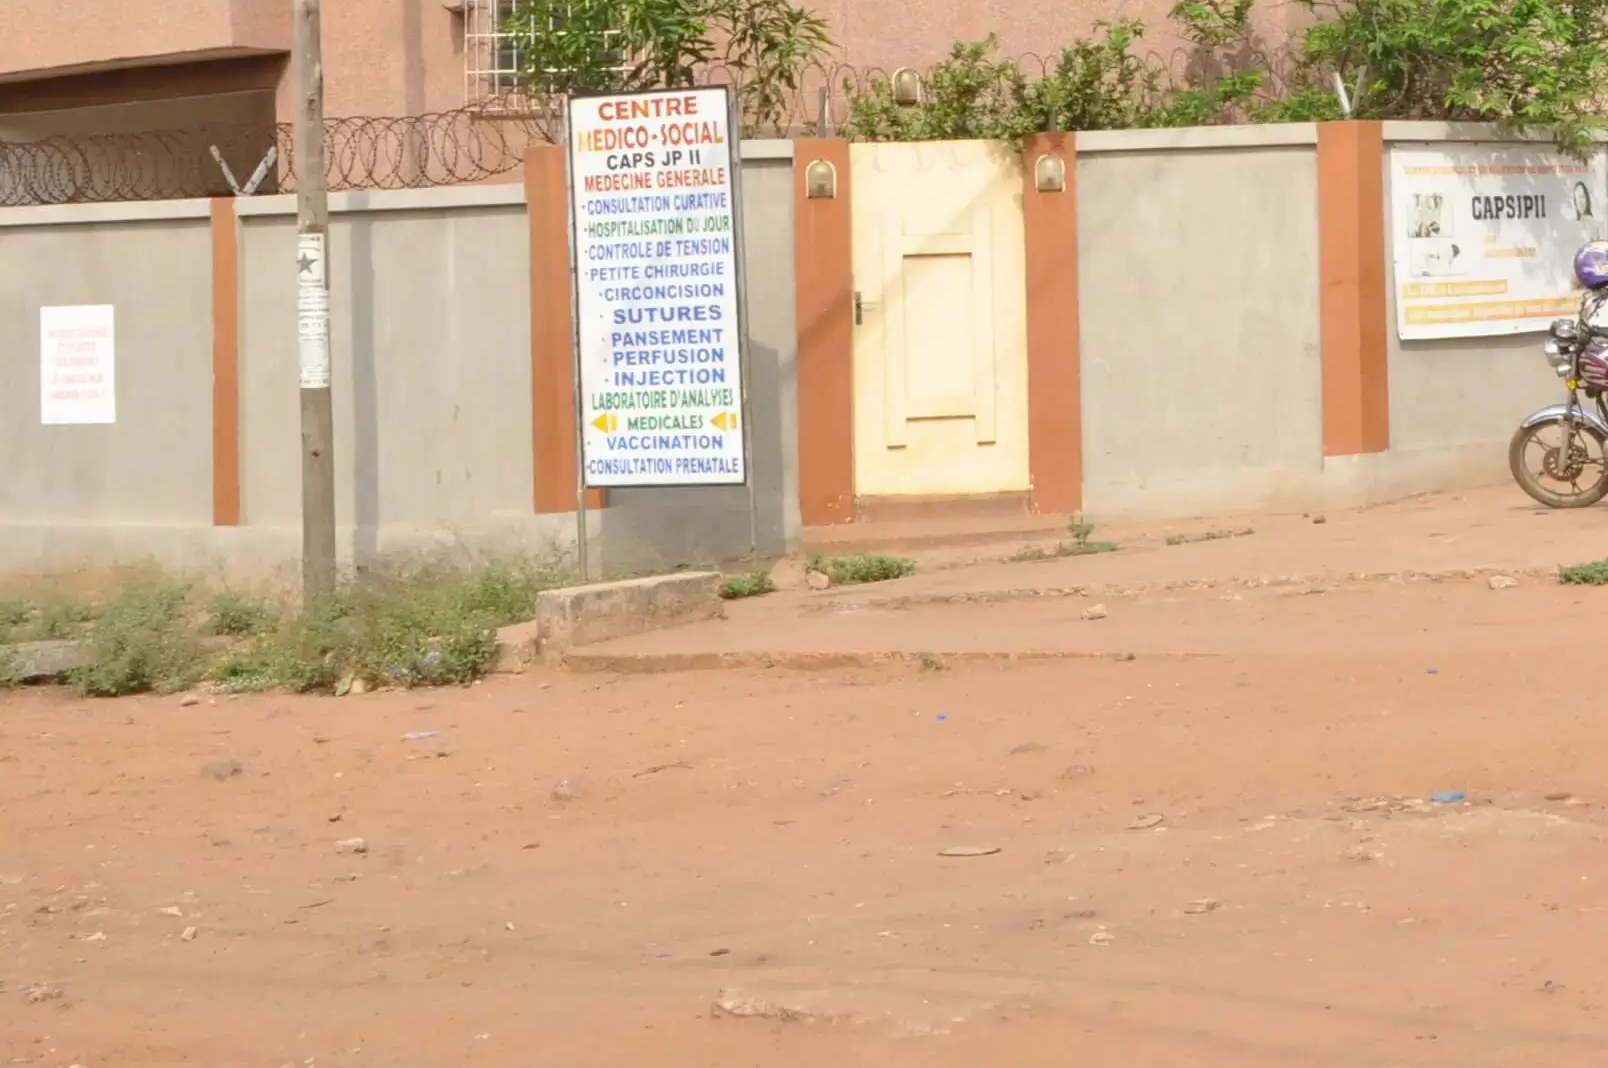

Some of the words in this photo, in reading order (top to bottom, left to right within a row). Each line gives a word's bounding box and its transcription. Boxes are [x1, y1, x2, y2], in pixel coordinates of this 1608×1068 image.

[598, 96, 699, 121] CENTRE
[606, 152, 656, 171] CAPS
[661, 150, 683, 166] JP
[584, 172, 652, 192] MEDECINE
[656, 168, 726, 189] GENERALE
[587, 196, 670, 216] CONSULTATION
[673, 192, 728, 211] CURATIVE
[588, 217, 684, 239] HOSPITALISATION
[702, 215, 731, 233] JOUR
[588, 241, 654, 261] CONTROLE
[656, 240, 673, 257] DE
[676, 237, 729, 256] TENSION
[590, 265, 640, 282] PETITE
[644, 261, 725, 279] CHIRURGIE
[604, 283, 724, 302] CIRCONCISION
[613, 304, 723, 325] SUTURES
[611, 328, 723, 348] PANSEMENT
[613, 348, 725, 367] PERFUSION
[614, 368, 726, 387] INJECTION
[591, 391, 667, 411] LABORATOIRE
[627, 414, 704, 431] MEDICALES
[606, 435, 724, 451] VACCINATION
[590, 458, 672, 475] CONSULTATION
[676, 457, 739, 474] PRENATALE
